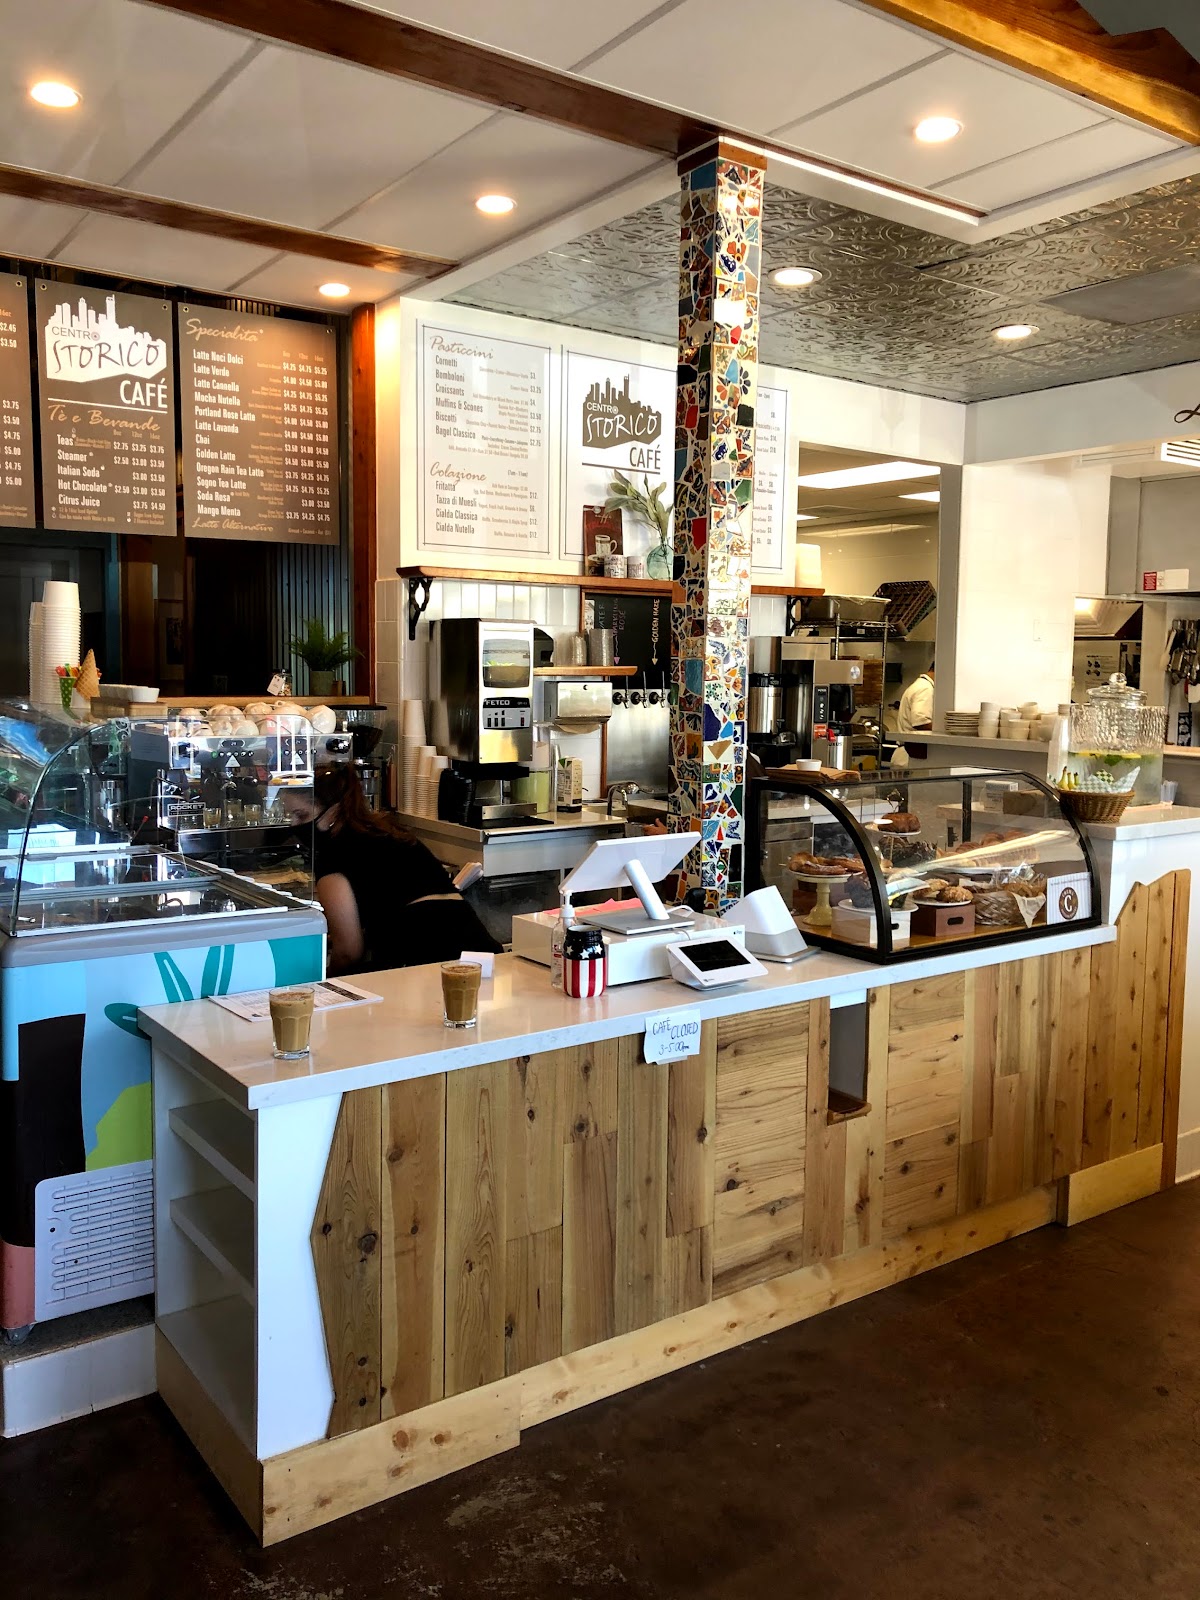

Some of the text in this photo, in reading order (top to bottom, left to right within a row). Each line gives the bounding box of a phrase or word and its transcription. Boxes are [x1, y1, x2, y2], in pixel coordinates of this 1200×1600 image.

[51, 326, 100, 341] CENTRO
[53, 340, 159, 373] STORICO
[193, 349, 209, 360] Latte
[211, 351, 225, 362] Noci
[227, 353, 243, 365] Dolci
[436, 355, 457, 367] Cornetti
[194, 363, 210, 374] Latte
[211, 365, 229, 377] Verde
[436, 369, 465, 382] Bomboloni
[194, 377, 210, 388] Latte
[212, 379, 239, 392] Cannella
[436, 383, 465, 396] Croissants
[120, 377, 168, 408] CAFÉ
[195, 392, 216, 403] Mocha
[218, 394, 240, 406] Nutella
[3, 400, 19, 410] $3.75
[436, 397, 456, 409] Muffins
[458, 400, 462, 409] &
[464, 401, 483, 412] Scones
[587, 402, 618, 414] CENTRO
[88, 409, 160, 431] Bevande
[195, 405, 221, 417] Portland
[223, 409, 238, 420] Rose
[240, 411, 255, 421] Latte
[436, 411, 457, 422] Biscotti
[3, 416, 20, 425] $3.50
[195, 420, 211, 430] Latte
[213, 421, 238, 433] Lavanda
[587, 413, 657, 442] STORICO
[4, 431, 21, 441] $4.75
[196, 434, 210, 444] Chai
[436, 425, 451, 437] Bagel
[453, 427, 475, 439] Classico
[57, 434, 73, 446] Teas
[114, 441, 129, 451] $2.75
[150, 444, 165, 454] $3.75
[57, 449, 87, 462] Steamer
[150, 459, 165, 468] $3.50
[196, 448, 218, 459] Golden
[220, 450, 235, 461] Latte
[630, 444, 661, 470] CAFÉ
[5, 461, 22, 471] $4.75
[57, 464, 81, 476] Italian
[82, 466, 100, 478] Soda
[150, 473, 165, 482] $3.50
[197, 462, 219, 475] Oregon
[221, 464, 235, 474] Rain
[236, 466, 247, 476] Tea
[249, 467, 264, 477] Latte
[430, 462, 487, 485] Colazione
[58, 479, 70, 490] Hot
[73, 480, 107, 493] Chocolate
[114, 484, 130, 494] $2.50
[151, 487, 165, 497] $3.50
[197, 476, 216, 489] Sogno
[218, 478, 229, 488] Tea
[231, 479, 246, 489] Latte
[436, 481, 456, 491] Fritatta
[58, 493, 166, 511] Citrus Juice $3.75 $4.50
[197, 490, 213, 501] Soda
[215, 492, 230, 502] Rosa
[436, 494, 450, 504] Tazza
[452, 496, 457, 505] di
[459, 496, 477, 507] Muesli
[198, 504, 219, 517] Mango
[221, 506, 241, 516] Menta
[436, 508, 453, 518] Cialda
[455, 509, 478, 520] Classica
[436, 522, 453, 532] Cialda
[455, 523, 475, 534] Nutella
[653, 1017, 671, 1035] CAFÉ
[671, 1022, 698, 1039] CLOSED
